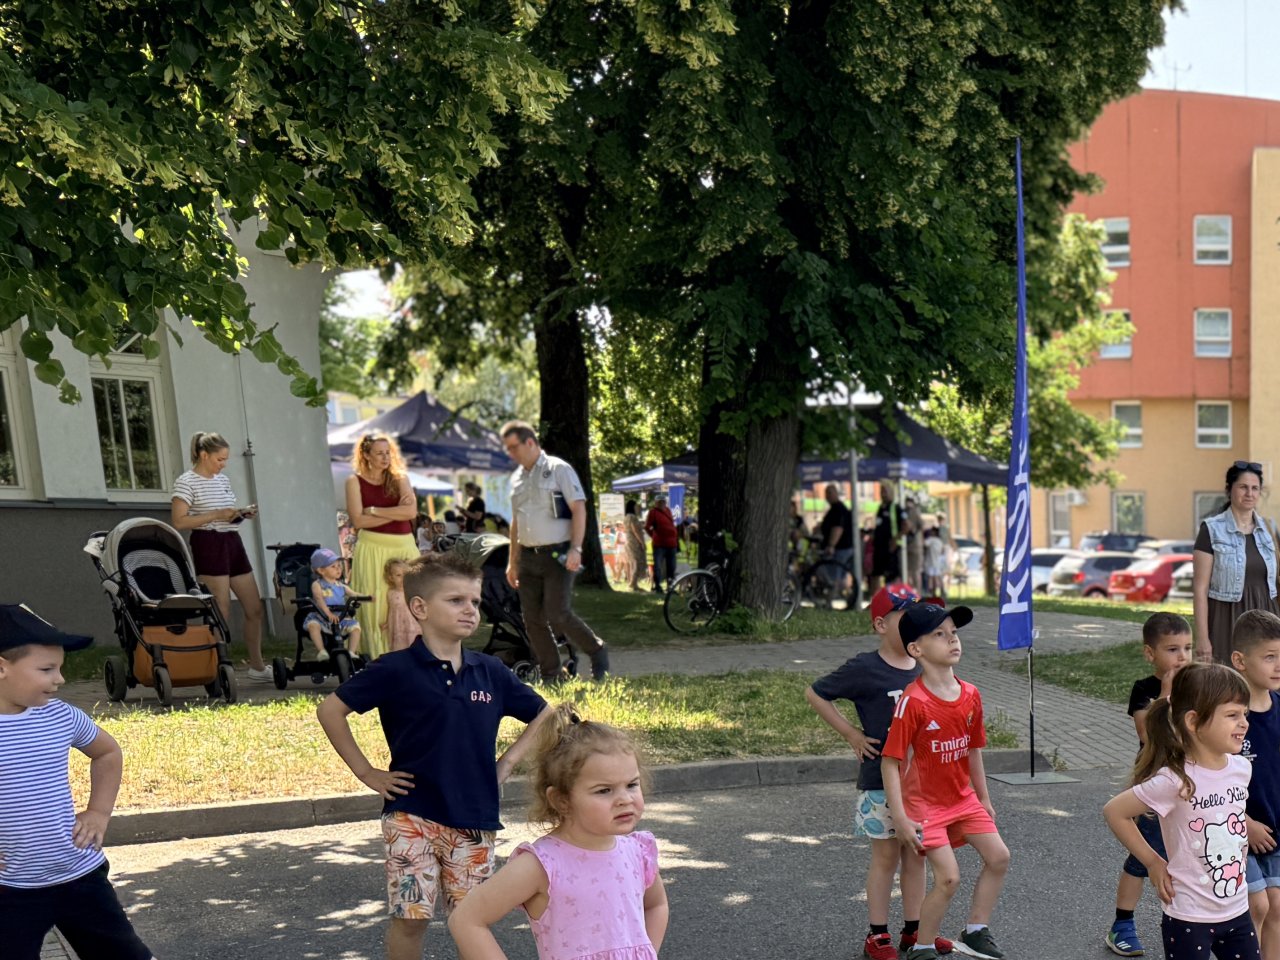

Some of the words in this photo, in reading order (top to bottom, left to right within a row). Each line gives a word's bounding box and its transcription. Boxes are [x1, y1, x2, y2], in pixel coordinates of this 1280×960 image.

[471, 691, 491, 703] GAP
[1189, 793, 1225, 810] Hello
[1227, 786, 1246, 803] Kitt
